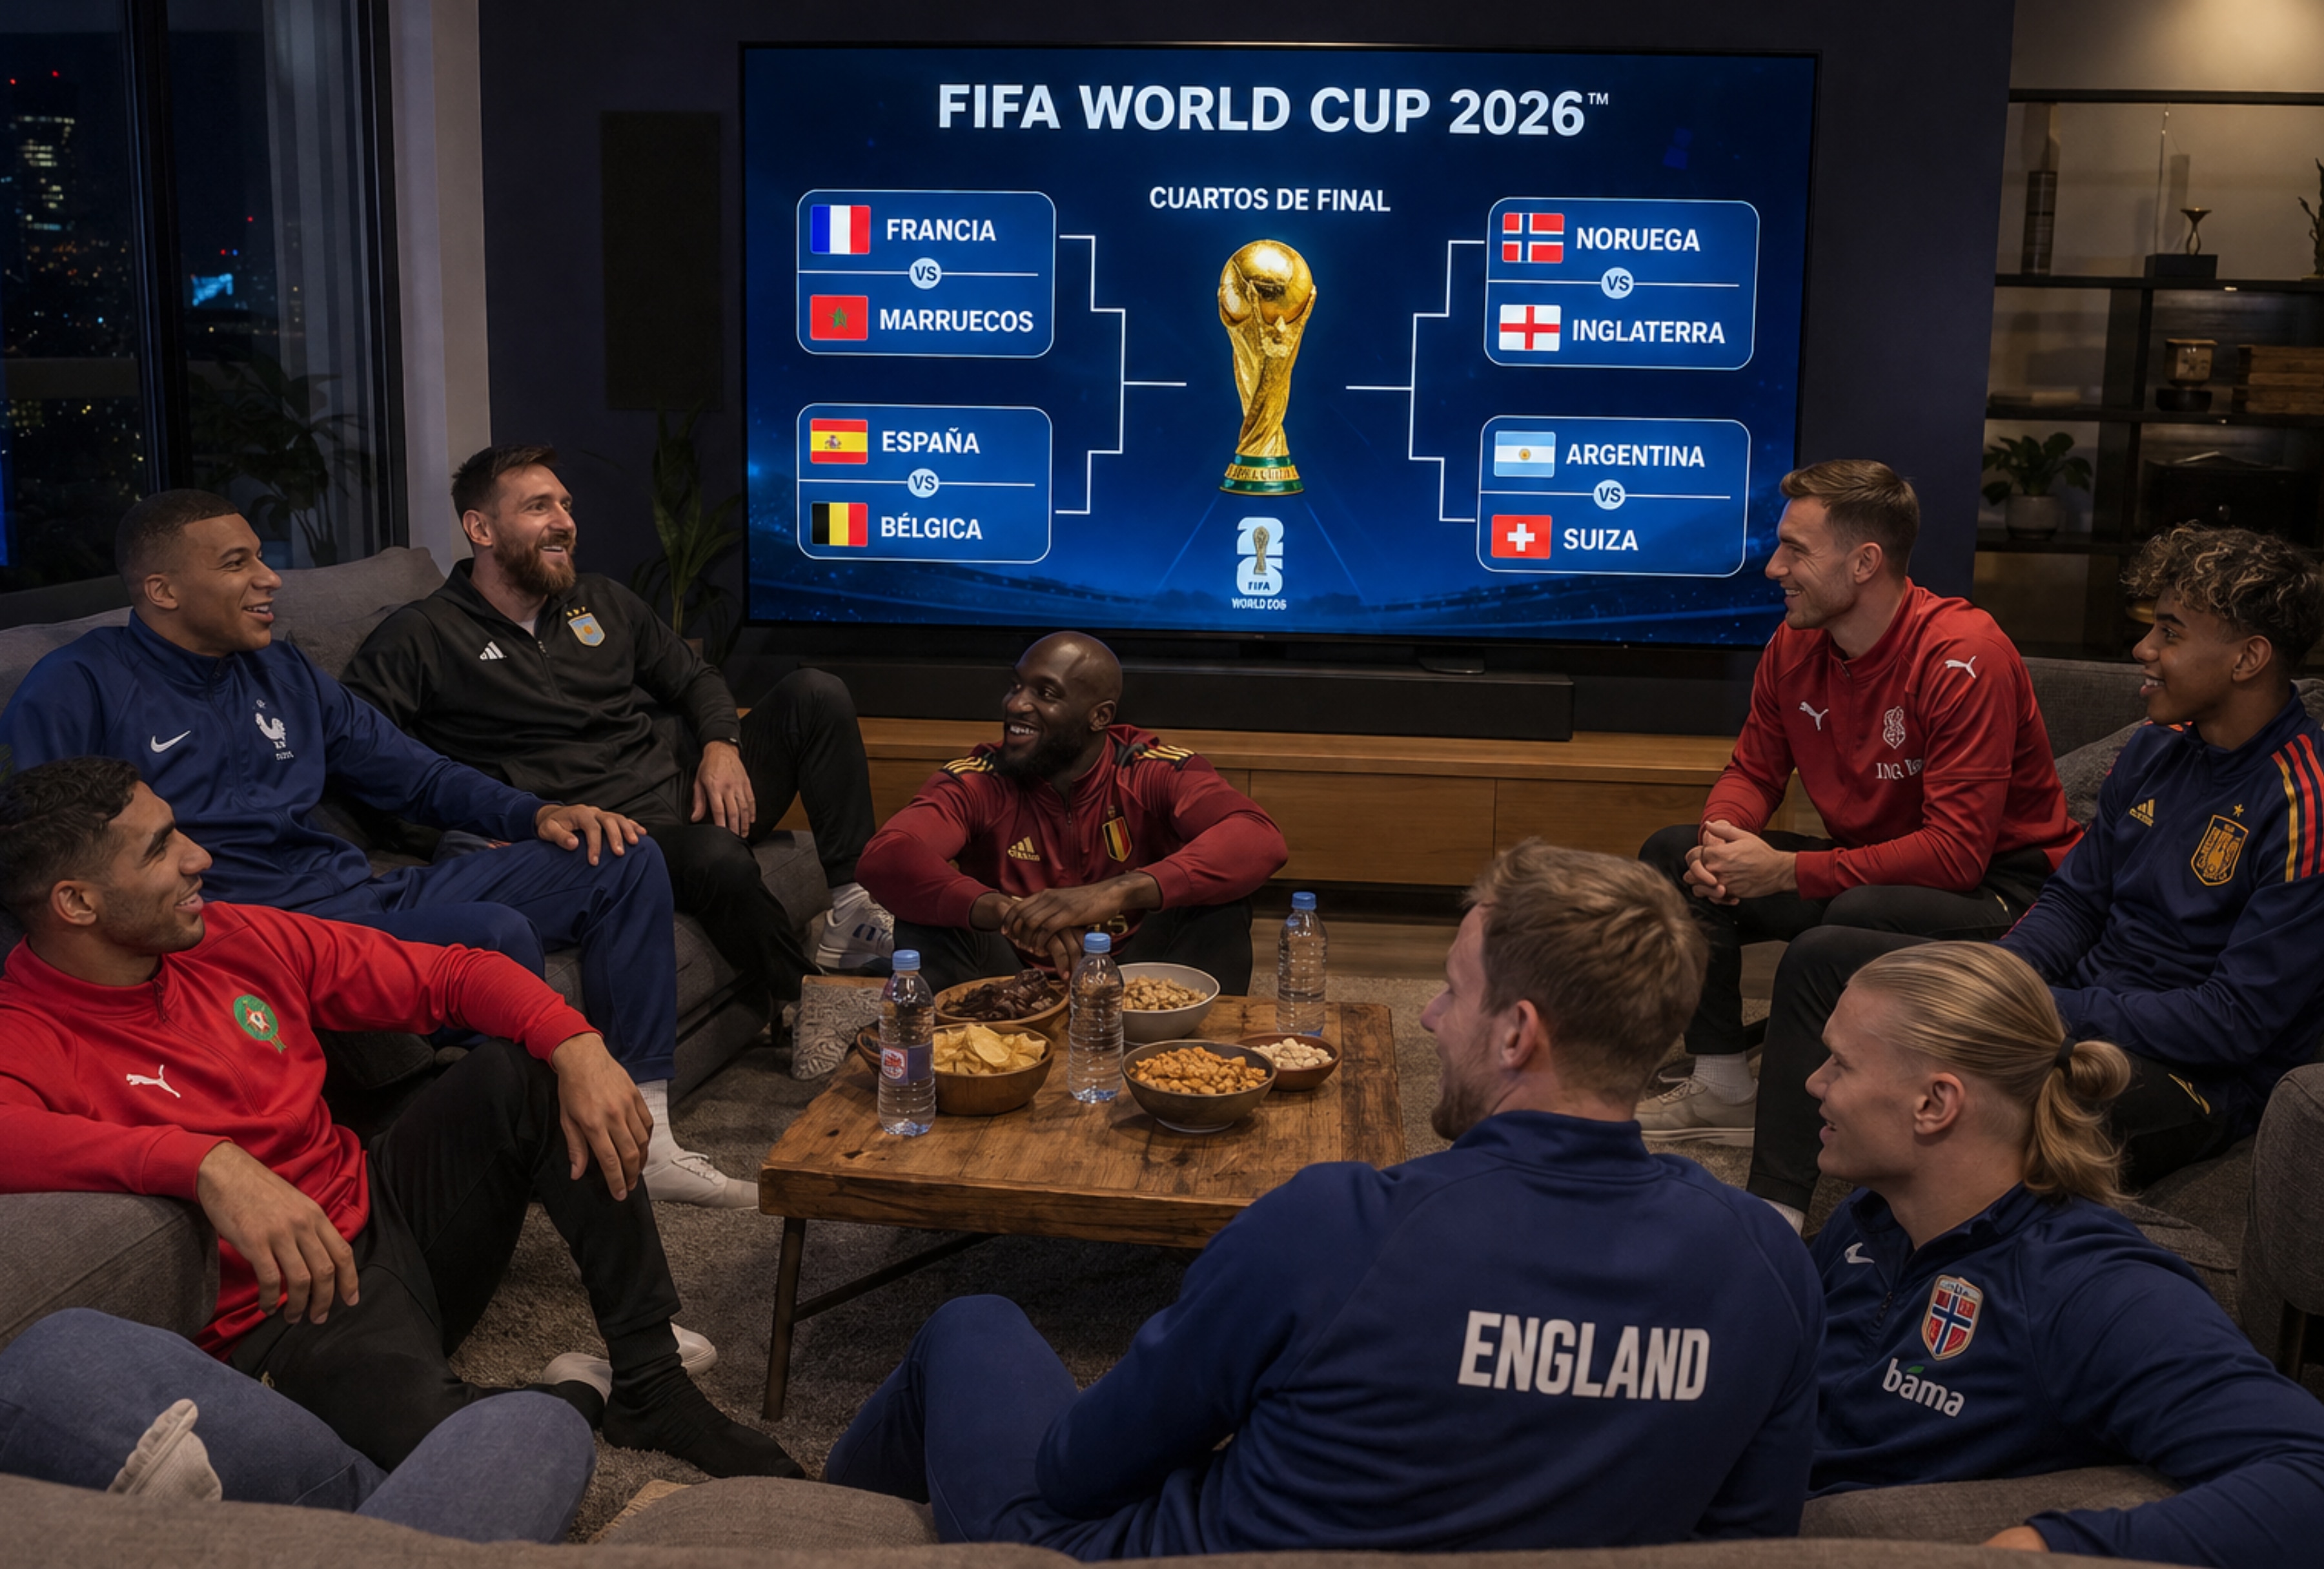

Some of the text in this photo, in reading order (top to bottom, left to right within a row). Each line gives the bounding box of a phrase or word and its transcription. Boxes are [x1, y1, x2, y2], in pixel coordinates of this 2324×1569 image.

[939, 84, 1061, 128] FIFA
[1079, 85, 1291, 131] WORLD
[1310, 87, 1431, 133] CUP
[1150, 186, 1391, 212] CUARTOS DE FINAL
[887, 218, 996, 241] FRANCIA
[1576, 227, 1700, 252] NORUEGA
[914, 266, 937, 281] VS
[1606, 275, 1630, 291] VS
[880, 309, 1034, 333] MARRUECOS
[1573, 319, 1725, 344] INGLATERRA
[882, 427, 980, 454] ESPAÑA
[1565, 444, 1705, 467] ARGENTINA
[912, 475, 935, 491] VS
[1598, 487, 1621, 503] VS
[881, 512, 983, 540] BÉLGICA
[1563, 528, 1639, 551] SUIZA
[1458, 1310, 1710, 1401] ENGLAND
[1882, 1358, 1965, 1417] bama
